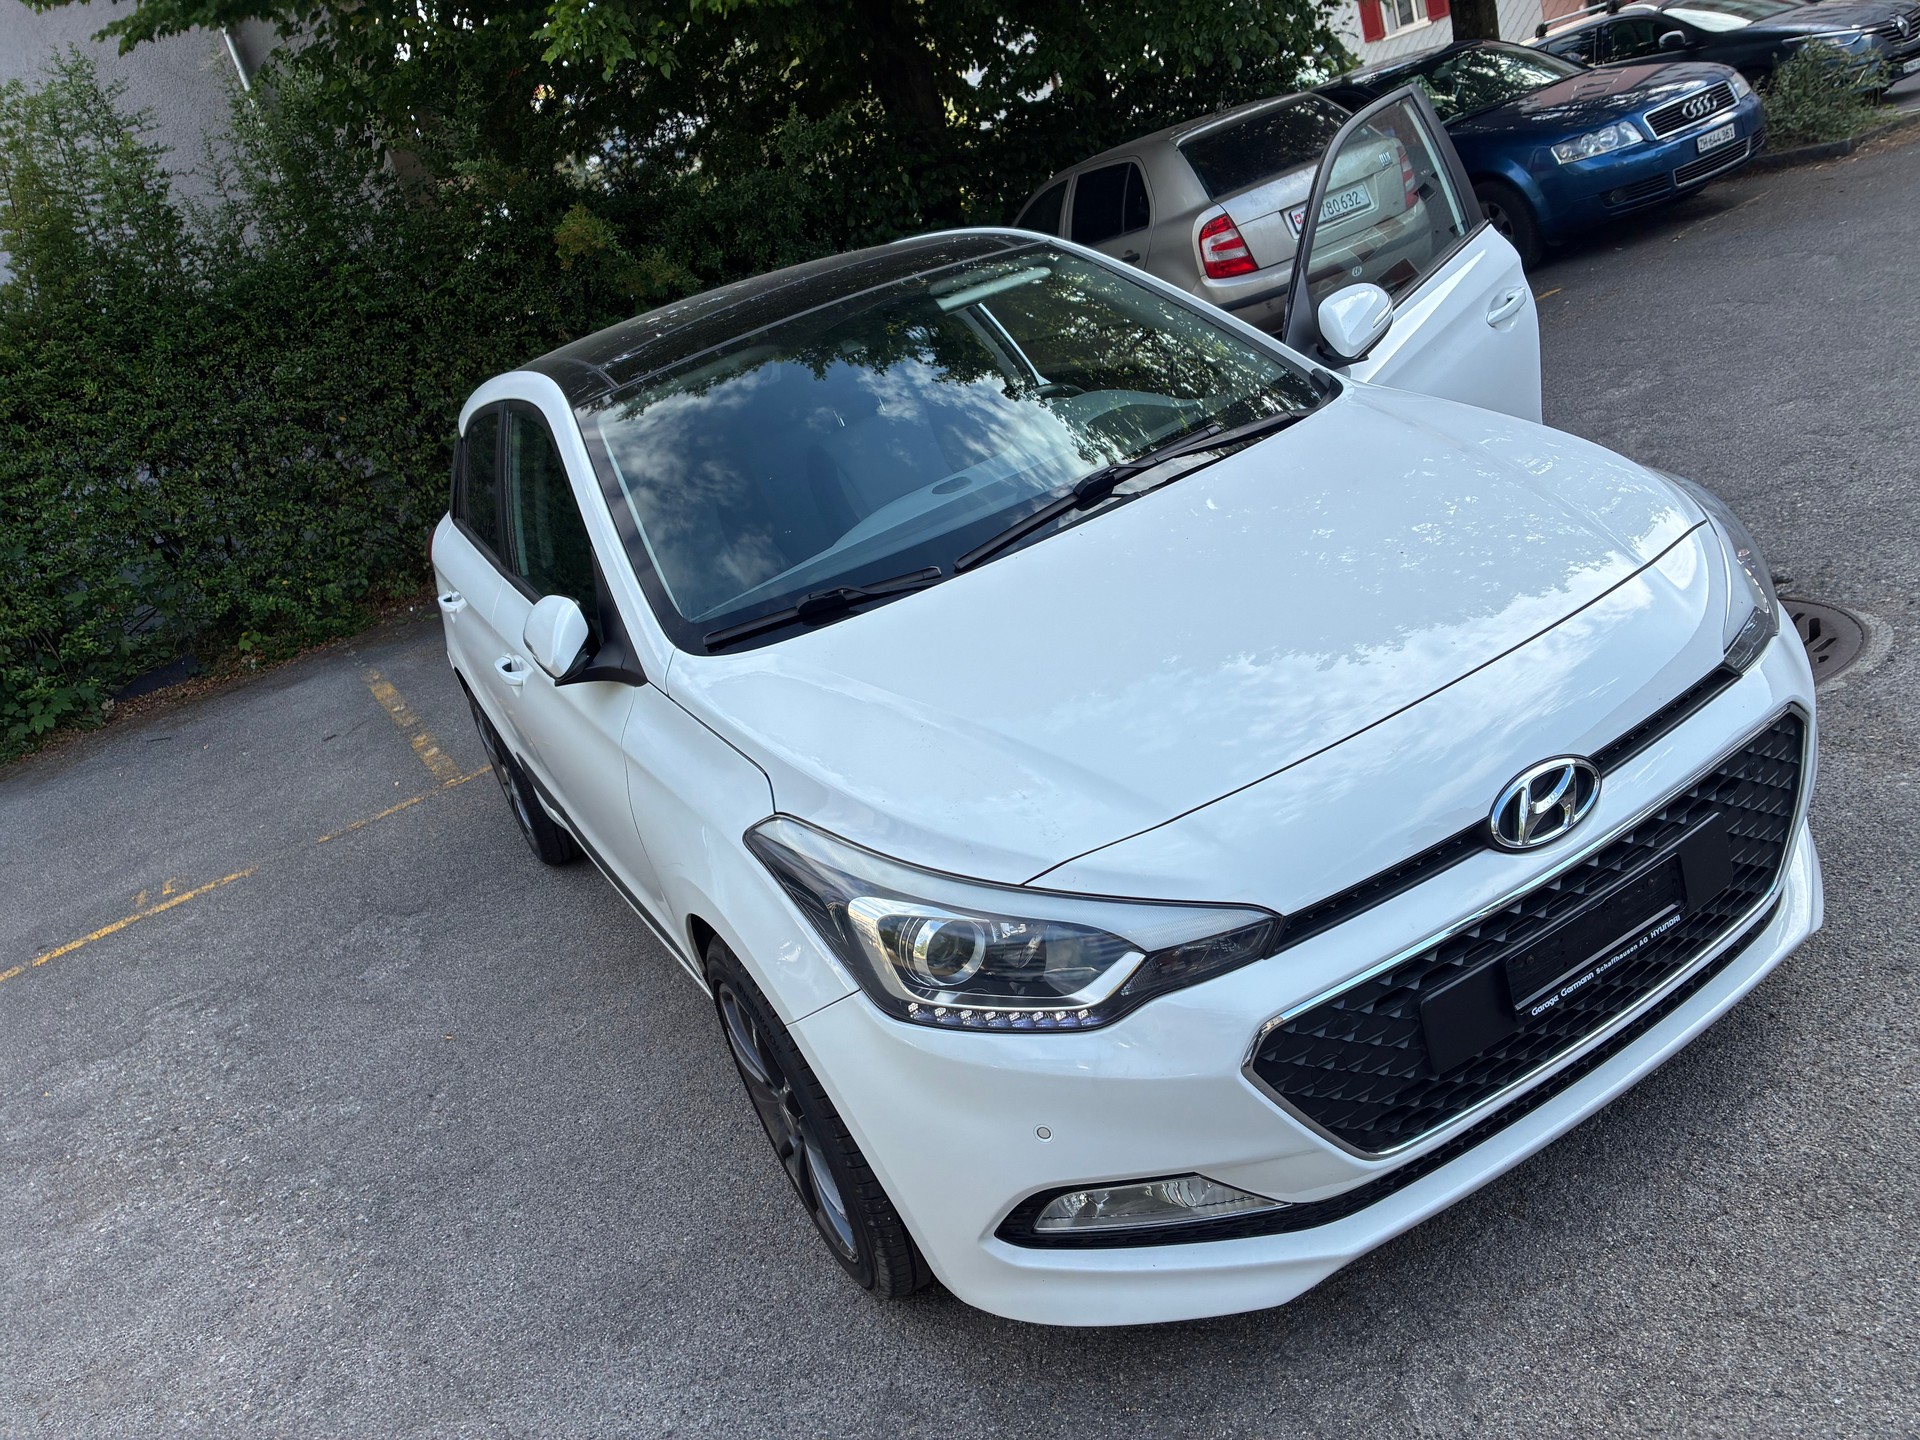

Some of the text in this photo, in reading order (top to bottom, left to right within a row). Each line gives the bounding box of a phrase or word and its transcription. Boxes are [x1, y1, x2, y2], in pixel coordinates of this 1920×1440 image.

[1531, 994, 1560, 1016] Garage
[1595, 944, 1638, 975] Schaffhausen
[1639, 937, 1649, 947] AG
[1650, 914, 1681, 939] HYUNDAI
